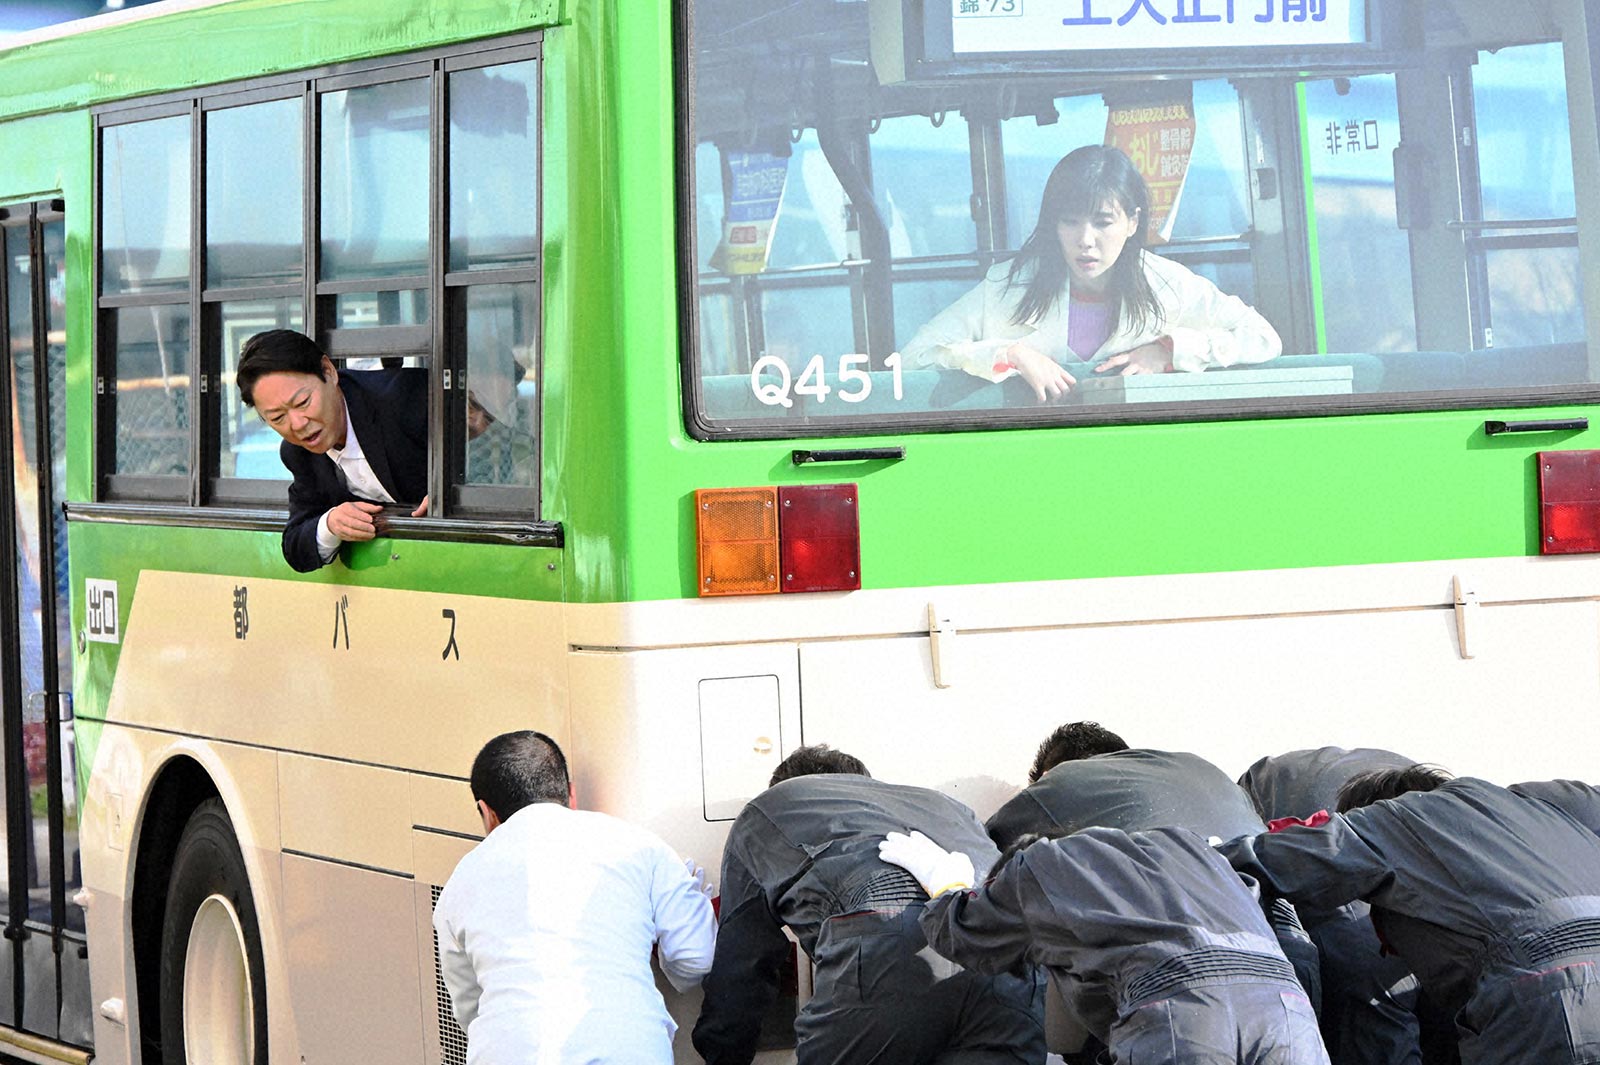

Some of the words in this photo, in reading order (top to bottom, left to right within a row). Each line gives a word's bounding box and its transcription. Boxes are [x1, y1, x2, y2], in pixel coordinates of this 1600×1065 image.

[1325, 120, 1379, 155] 非常口
[751, 352, 903, 408] Q451
[89, 585, 116, 635] 出口
[233, 584, 460, 661] 都バス
